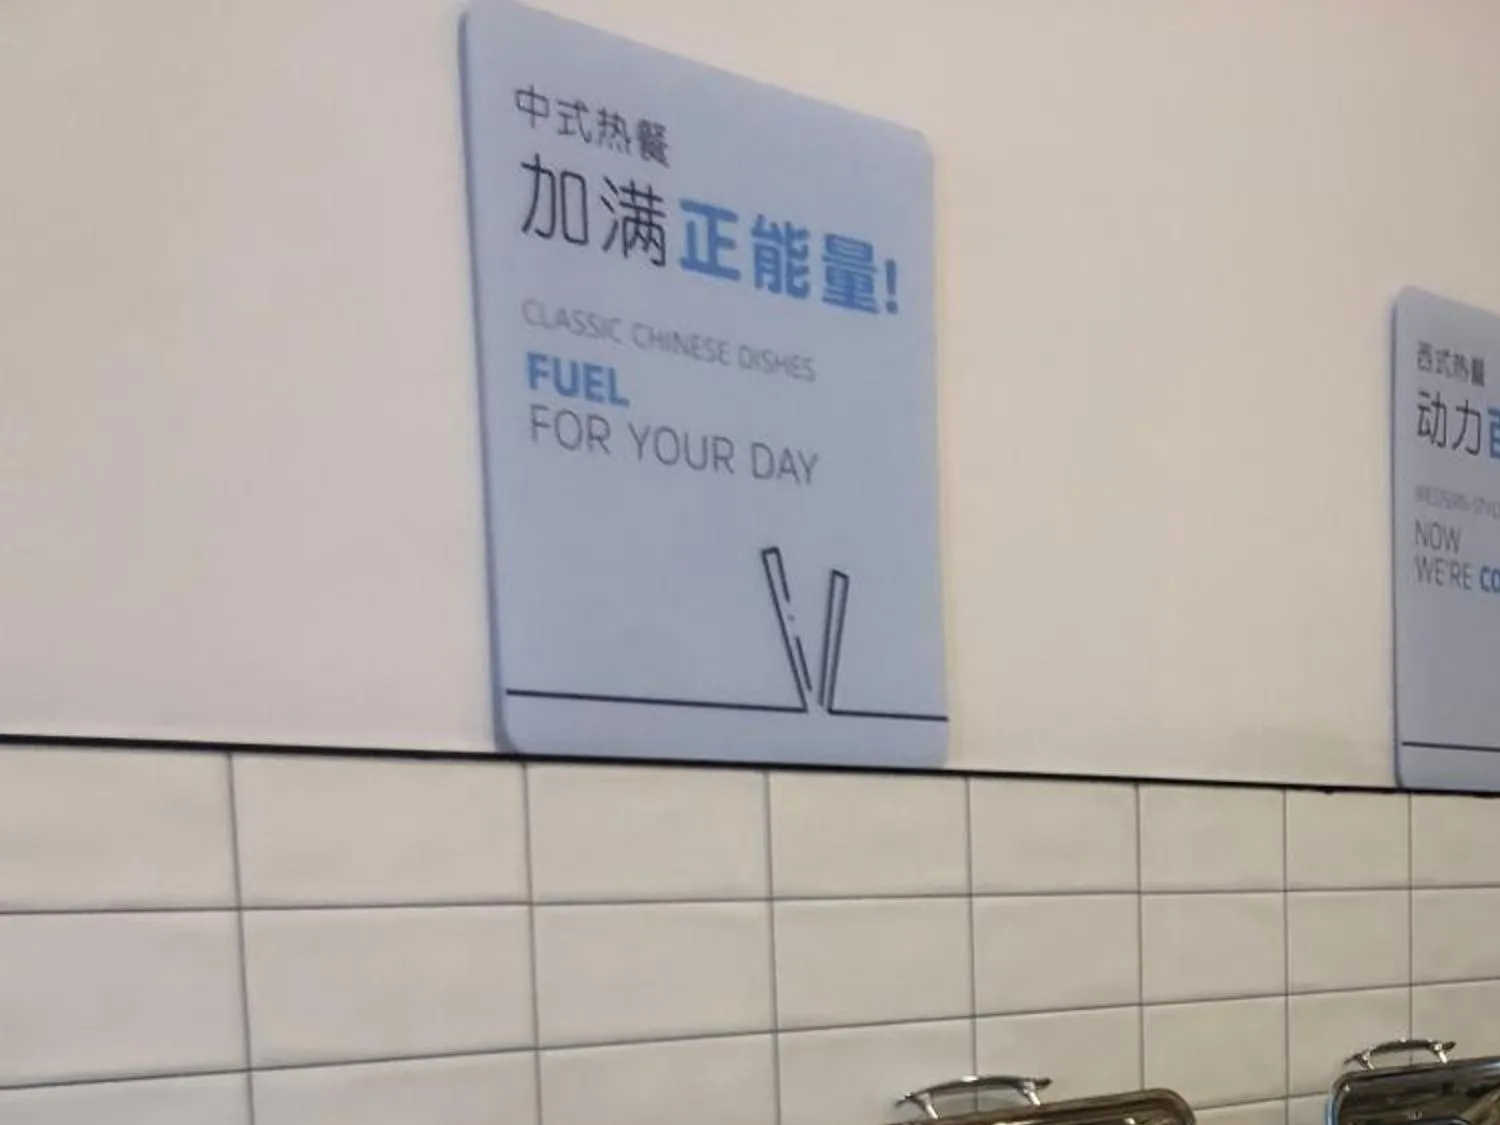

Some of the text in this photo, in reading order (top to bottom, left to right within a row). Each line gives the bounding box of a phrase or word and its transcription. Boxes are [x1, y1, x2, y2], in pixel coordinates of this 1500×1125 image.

[514, 85, 670, 168] 中式热餐
[520, 153, 898, 315] 加满正能量!
[522, 299, 816, 383] CLASSIC CHINESE DISHES
[526, 352, 630, 407] FUEL
[530, 405, 819, 485] FOR YOUR DAY
[1415, 519, 1461, 554] NOW
[1415, 555, 1473, 591] WE'RE
